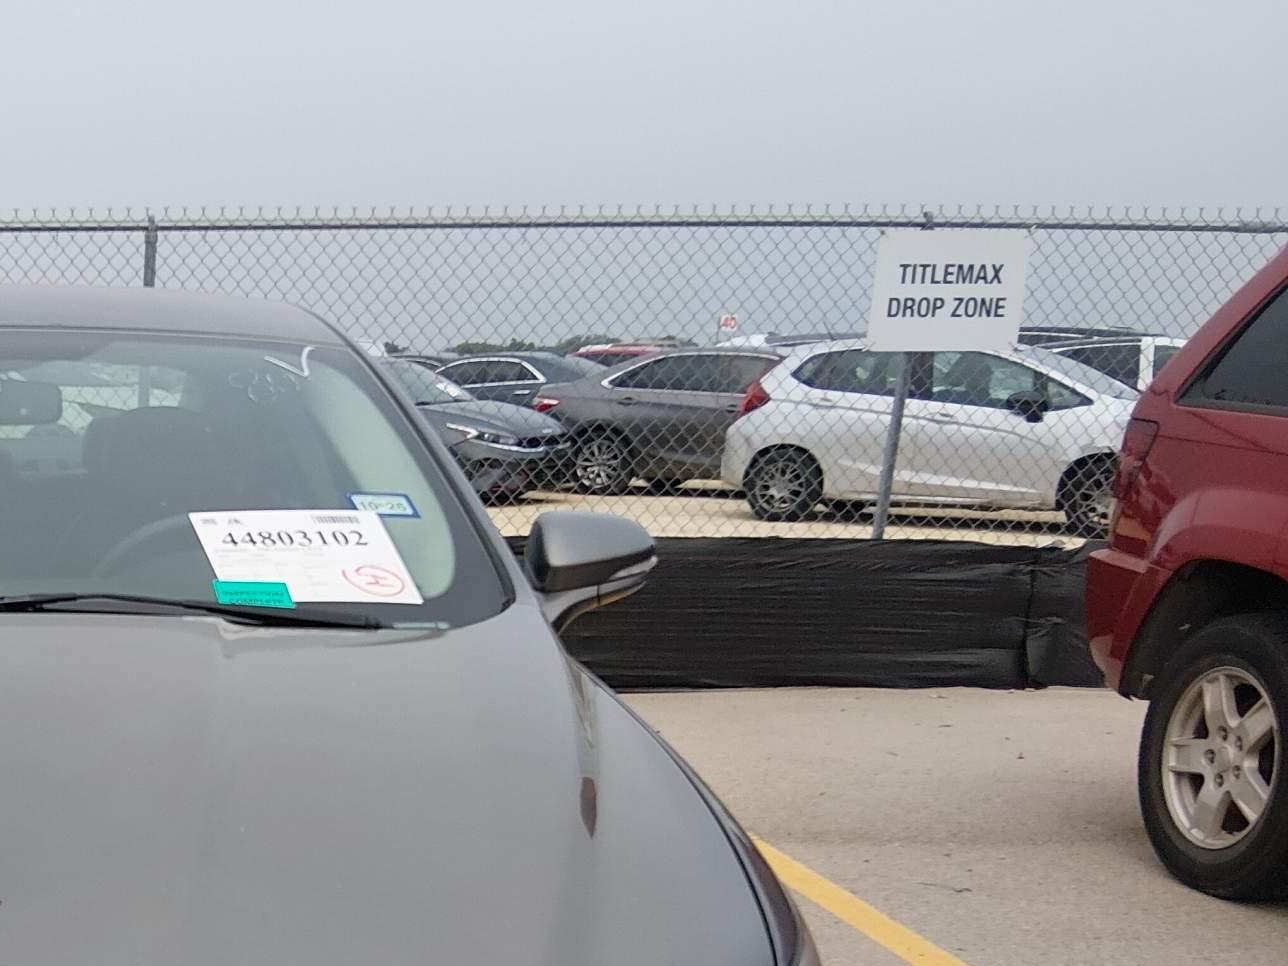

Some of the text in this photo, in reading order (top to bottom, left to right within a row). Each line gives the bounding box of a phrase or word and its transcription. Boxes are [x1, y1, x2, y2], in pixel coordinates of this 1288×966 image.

[899, 263, 1005, 285] TITLEMAX
[887, 297, 1007, 318] DROP ZONE
[222, 530, 369, 548] 44803102
